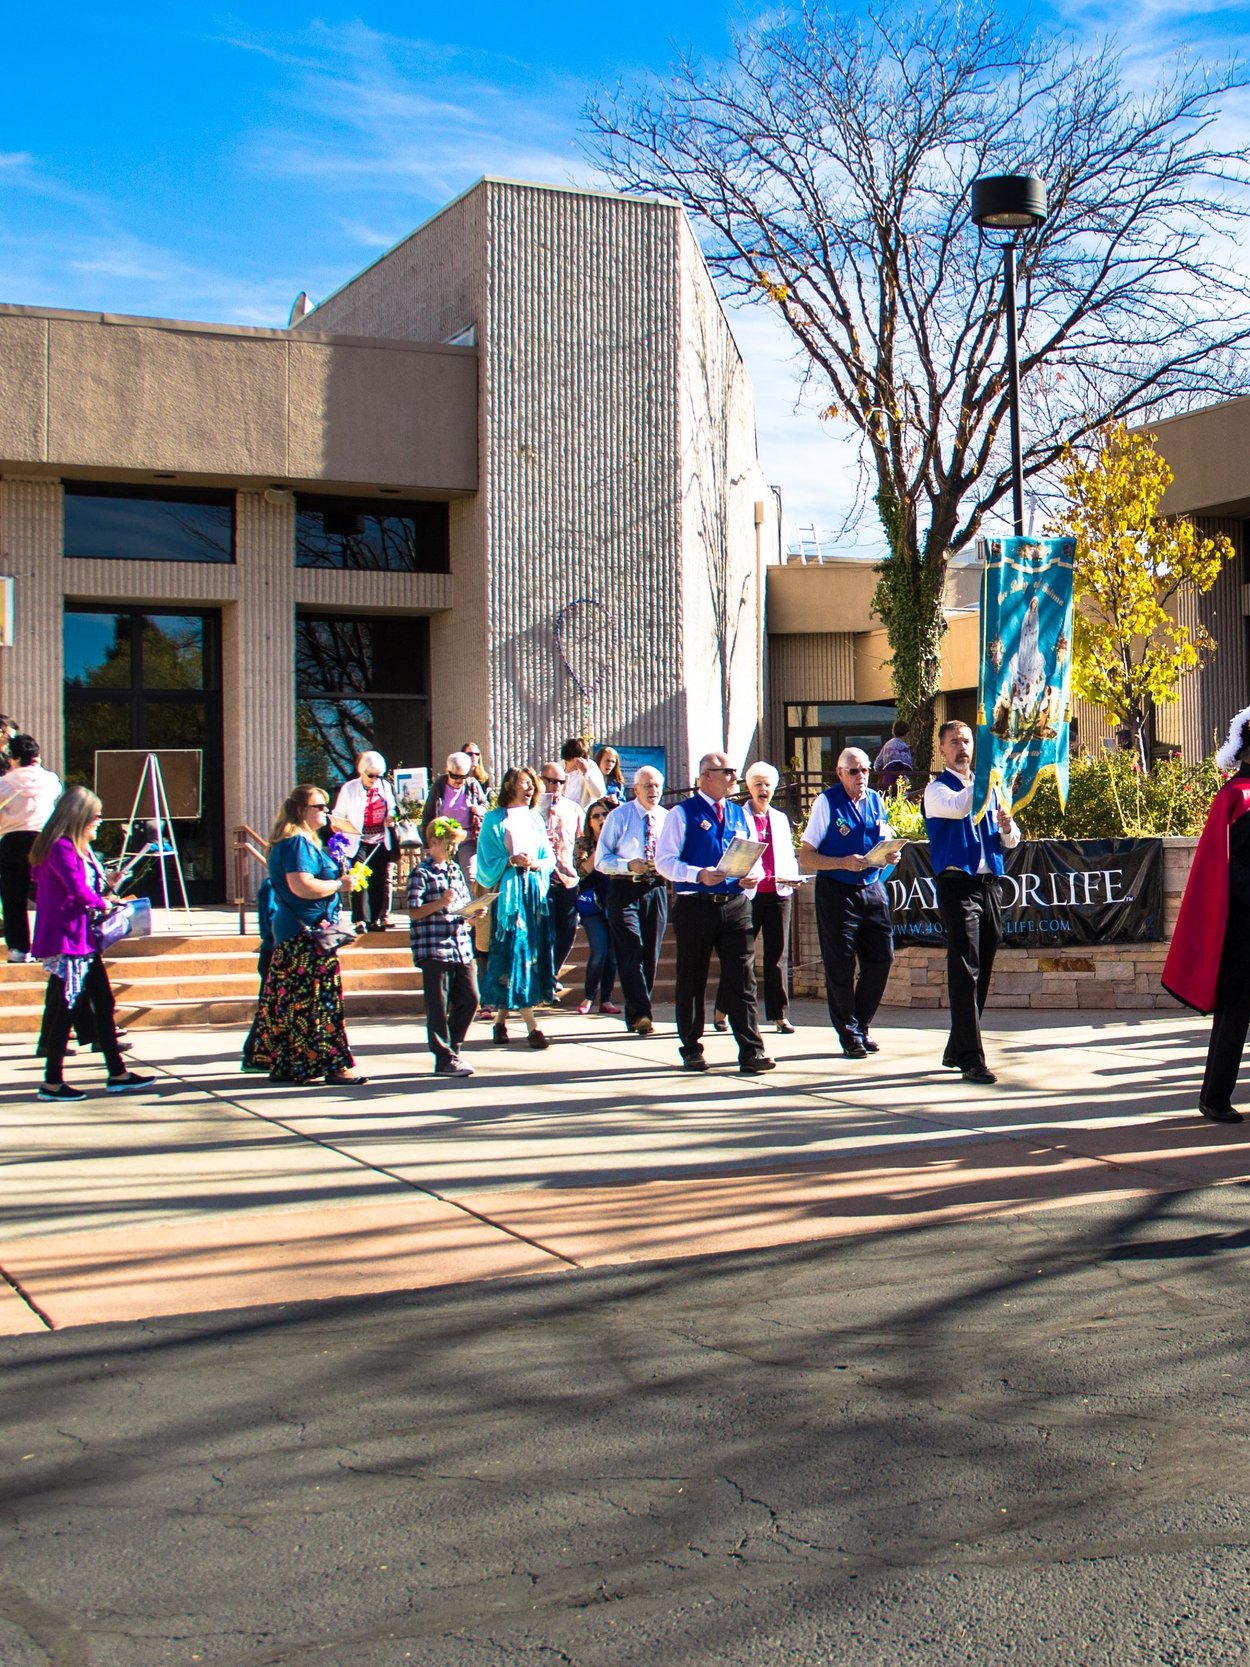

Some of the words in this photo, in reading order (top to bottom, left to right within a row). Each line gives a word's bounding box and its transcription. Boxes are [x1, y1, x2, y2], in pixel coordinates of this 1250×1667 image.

[888, 877, 939, 912] DAY
[999, 873, 1050, 909] OR
[1049, 868, 1126, 906] LIFE
